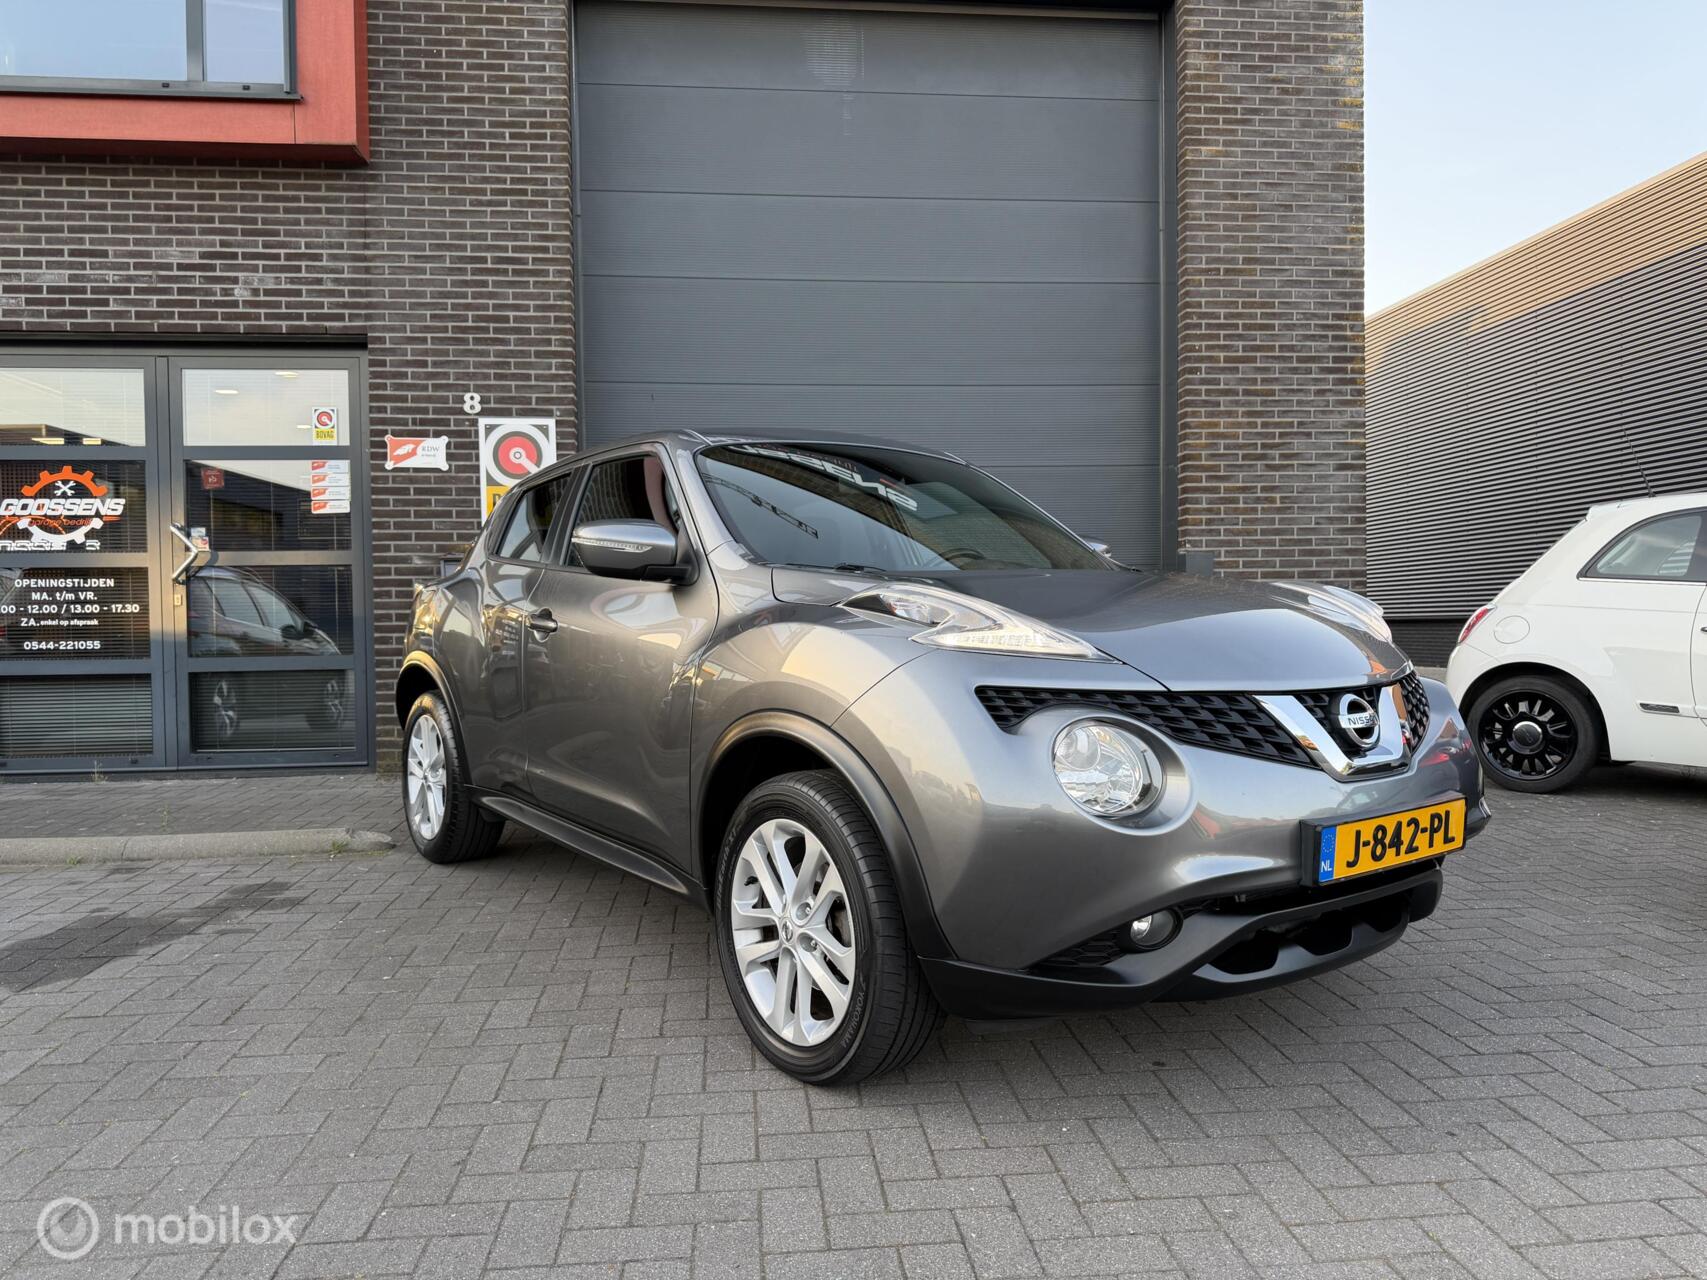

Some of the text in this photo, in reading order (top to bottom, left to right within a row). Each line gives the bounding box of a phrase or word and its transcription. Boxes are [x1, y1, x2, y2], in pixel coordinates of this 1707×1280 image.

[463, 392, 482, 414] 8
[421, 445, 440, 453] RDW
[0, 498, 126, 516] GOOSSENS
[14, 578, 115, 588] OPENINGSTIJDEN
[31, 591, 98, 601] MA. t/m VR.
[27, 604, 58, 614] 12.00
[61, 603, 67, 614] /
[70, 604, 100, 613] 13.00
[111, 603, 140, 613] 17.30
[20, 617, 40, 627] ZA.
[40, 618, 59, 626] enkel
[70, 618, 99, 627] afspraak
[23, 640, 101, 650] 0544-221055
[1345, 809, 1456, 869] J-842-PL
[1320, 859, 1333, 873] NL
